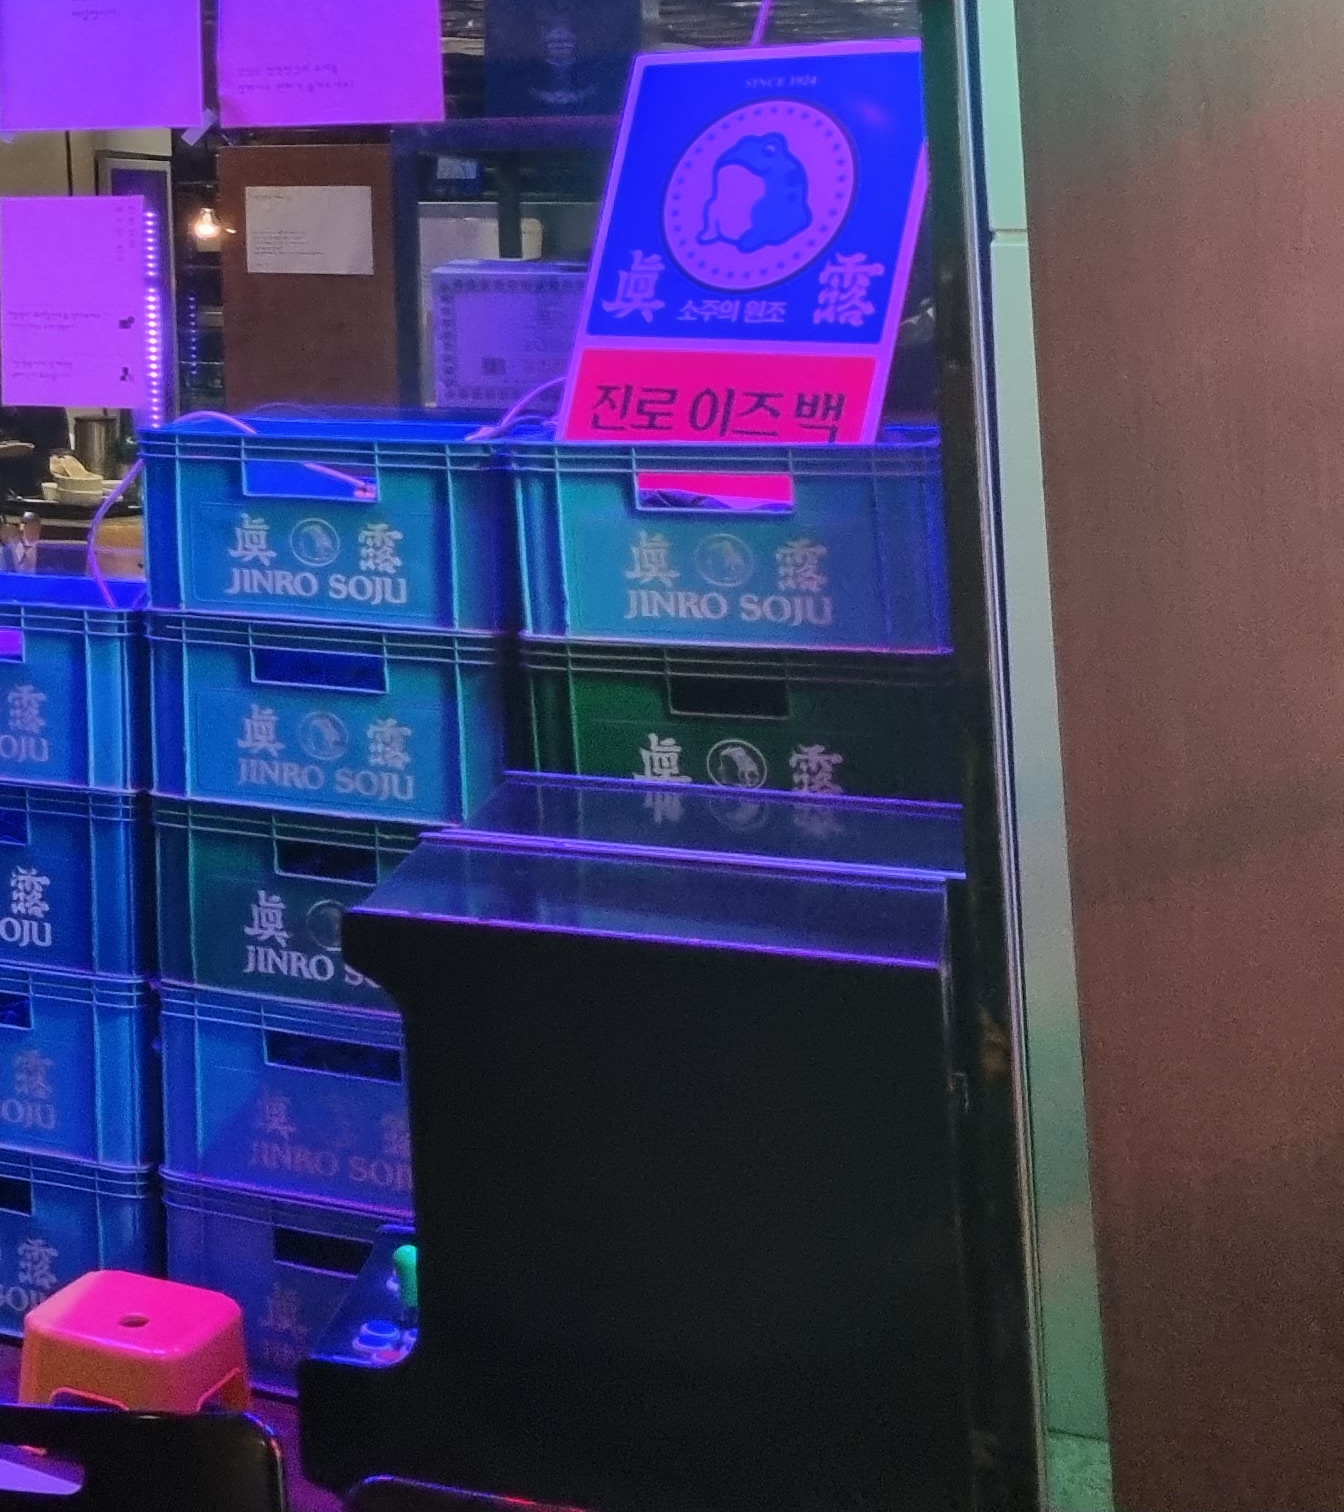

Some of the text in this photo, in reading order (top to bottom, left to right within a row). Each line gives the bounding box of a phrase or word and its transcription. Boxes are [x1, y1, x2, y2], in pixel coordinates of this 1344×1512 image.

[744, 75, 786, 89] SINCE
[677, 298, 787, 324] 소주의 원조
[226, 567, 408, 605] JINRO SOJU
[624, 589, 834, 626] JINRO SOJU
[237, 757, 414, 801] JINRO SOJU
[243, 945, 334, 982] JINRO
